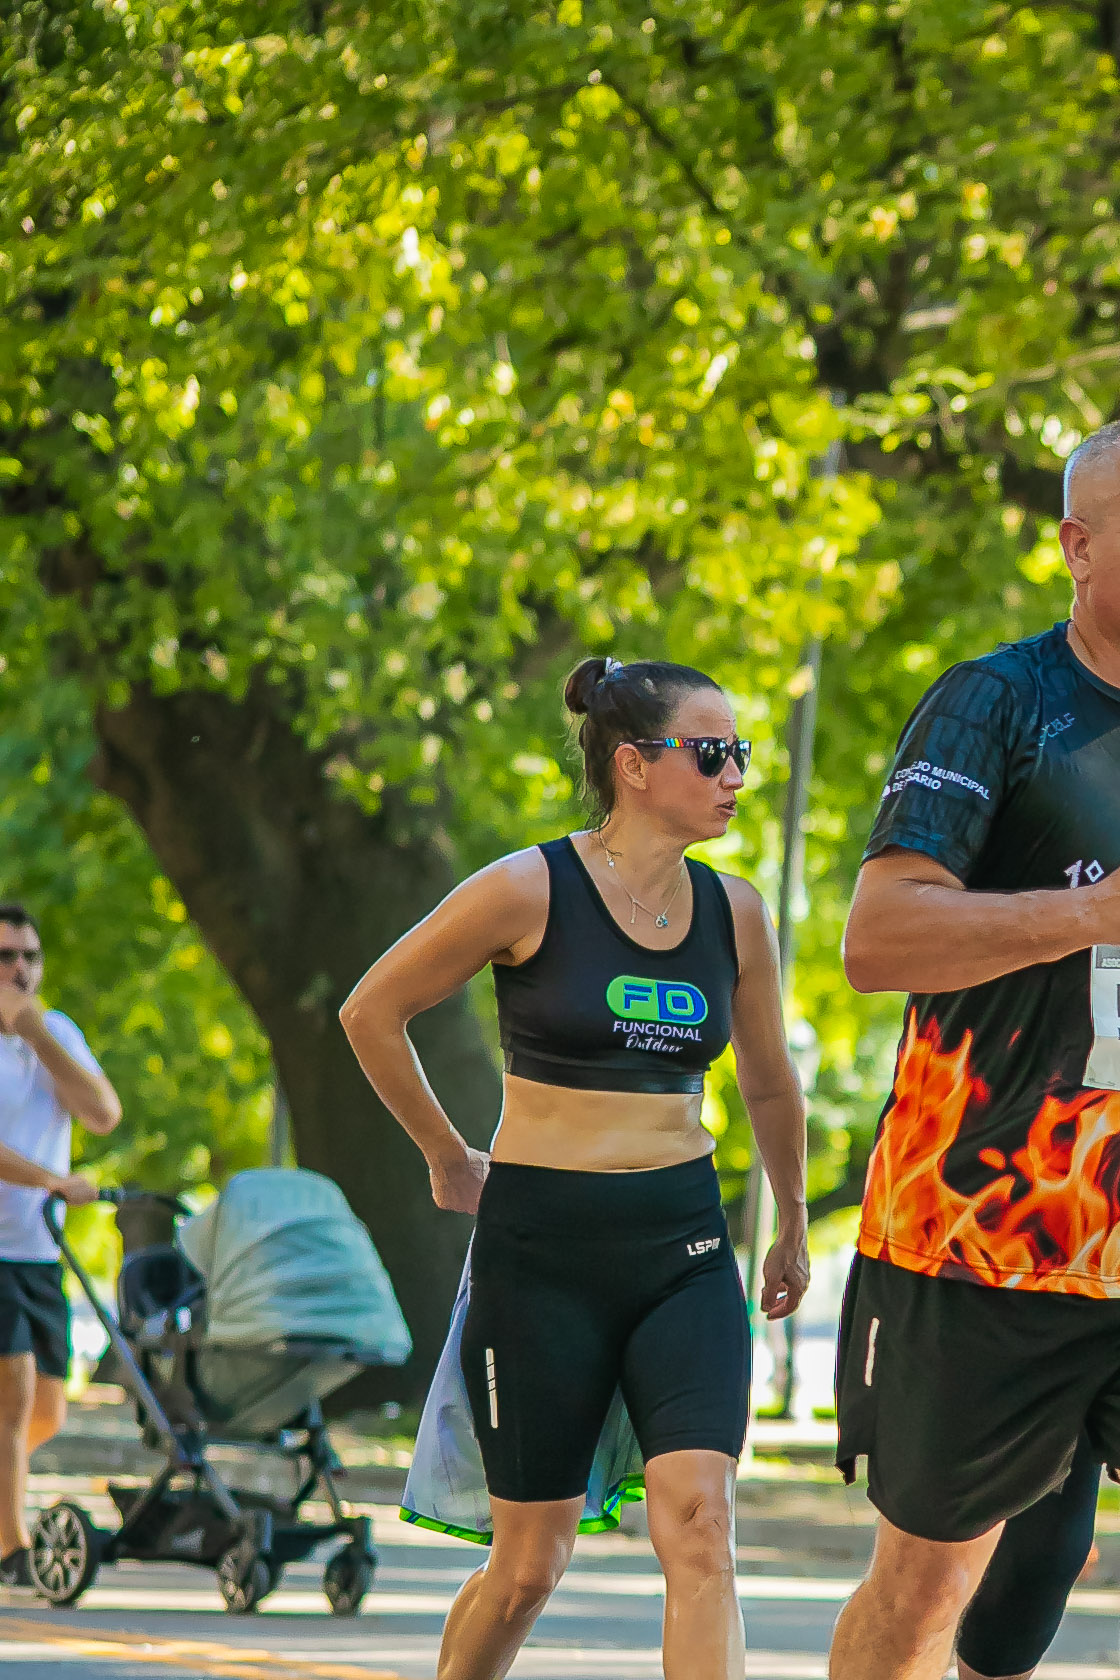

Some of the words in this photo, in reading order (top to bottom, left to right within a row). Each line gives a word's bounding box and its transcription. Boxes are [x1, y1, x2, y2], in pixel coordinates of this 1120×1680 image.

[931, 766, 990, 800] MUNICIPAL
[612, 1020, 703, 1042] FUNCIONAL
[625, 1033, 684, 1053] Outdoor
